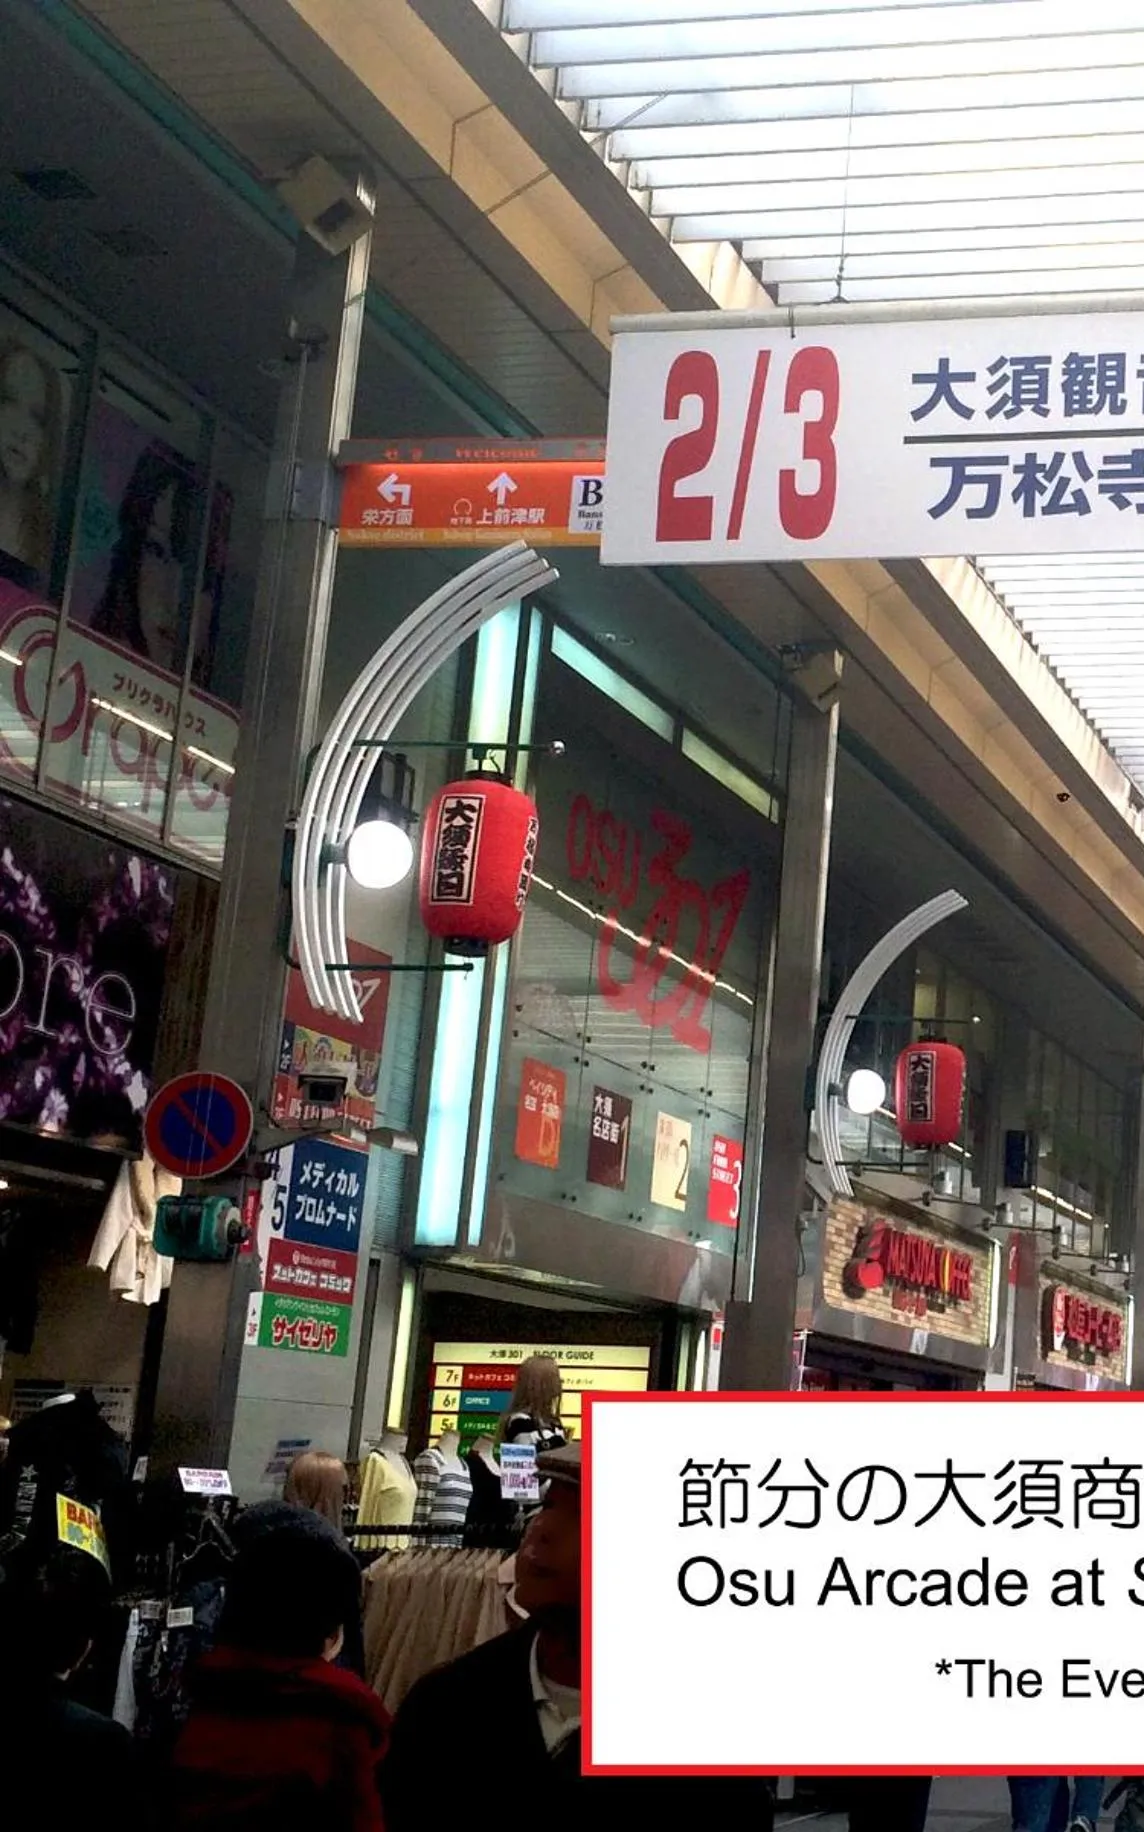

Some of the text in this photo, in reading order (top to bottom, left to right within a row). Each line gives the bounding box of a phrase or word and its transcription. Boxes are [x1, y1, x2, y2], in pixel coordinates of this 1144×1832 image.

[656, 346, 840, 542] 2/3
[299, 1160, 360, 1199] メディカル
[674, 1137, 691, 1201] 2
[271, 1183, 288, 1232] 5
[295, 1193, 357, 1233] プロムナード
[271, 1313, 338, 1351] サイゼリヤ
[566, 1351, 594, 1361] GUIDE
